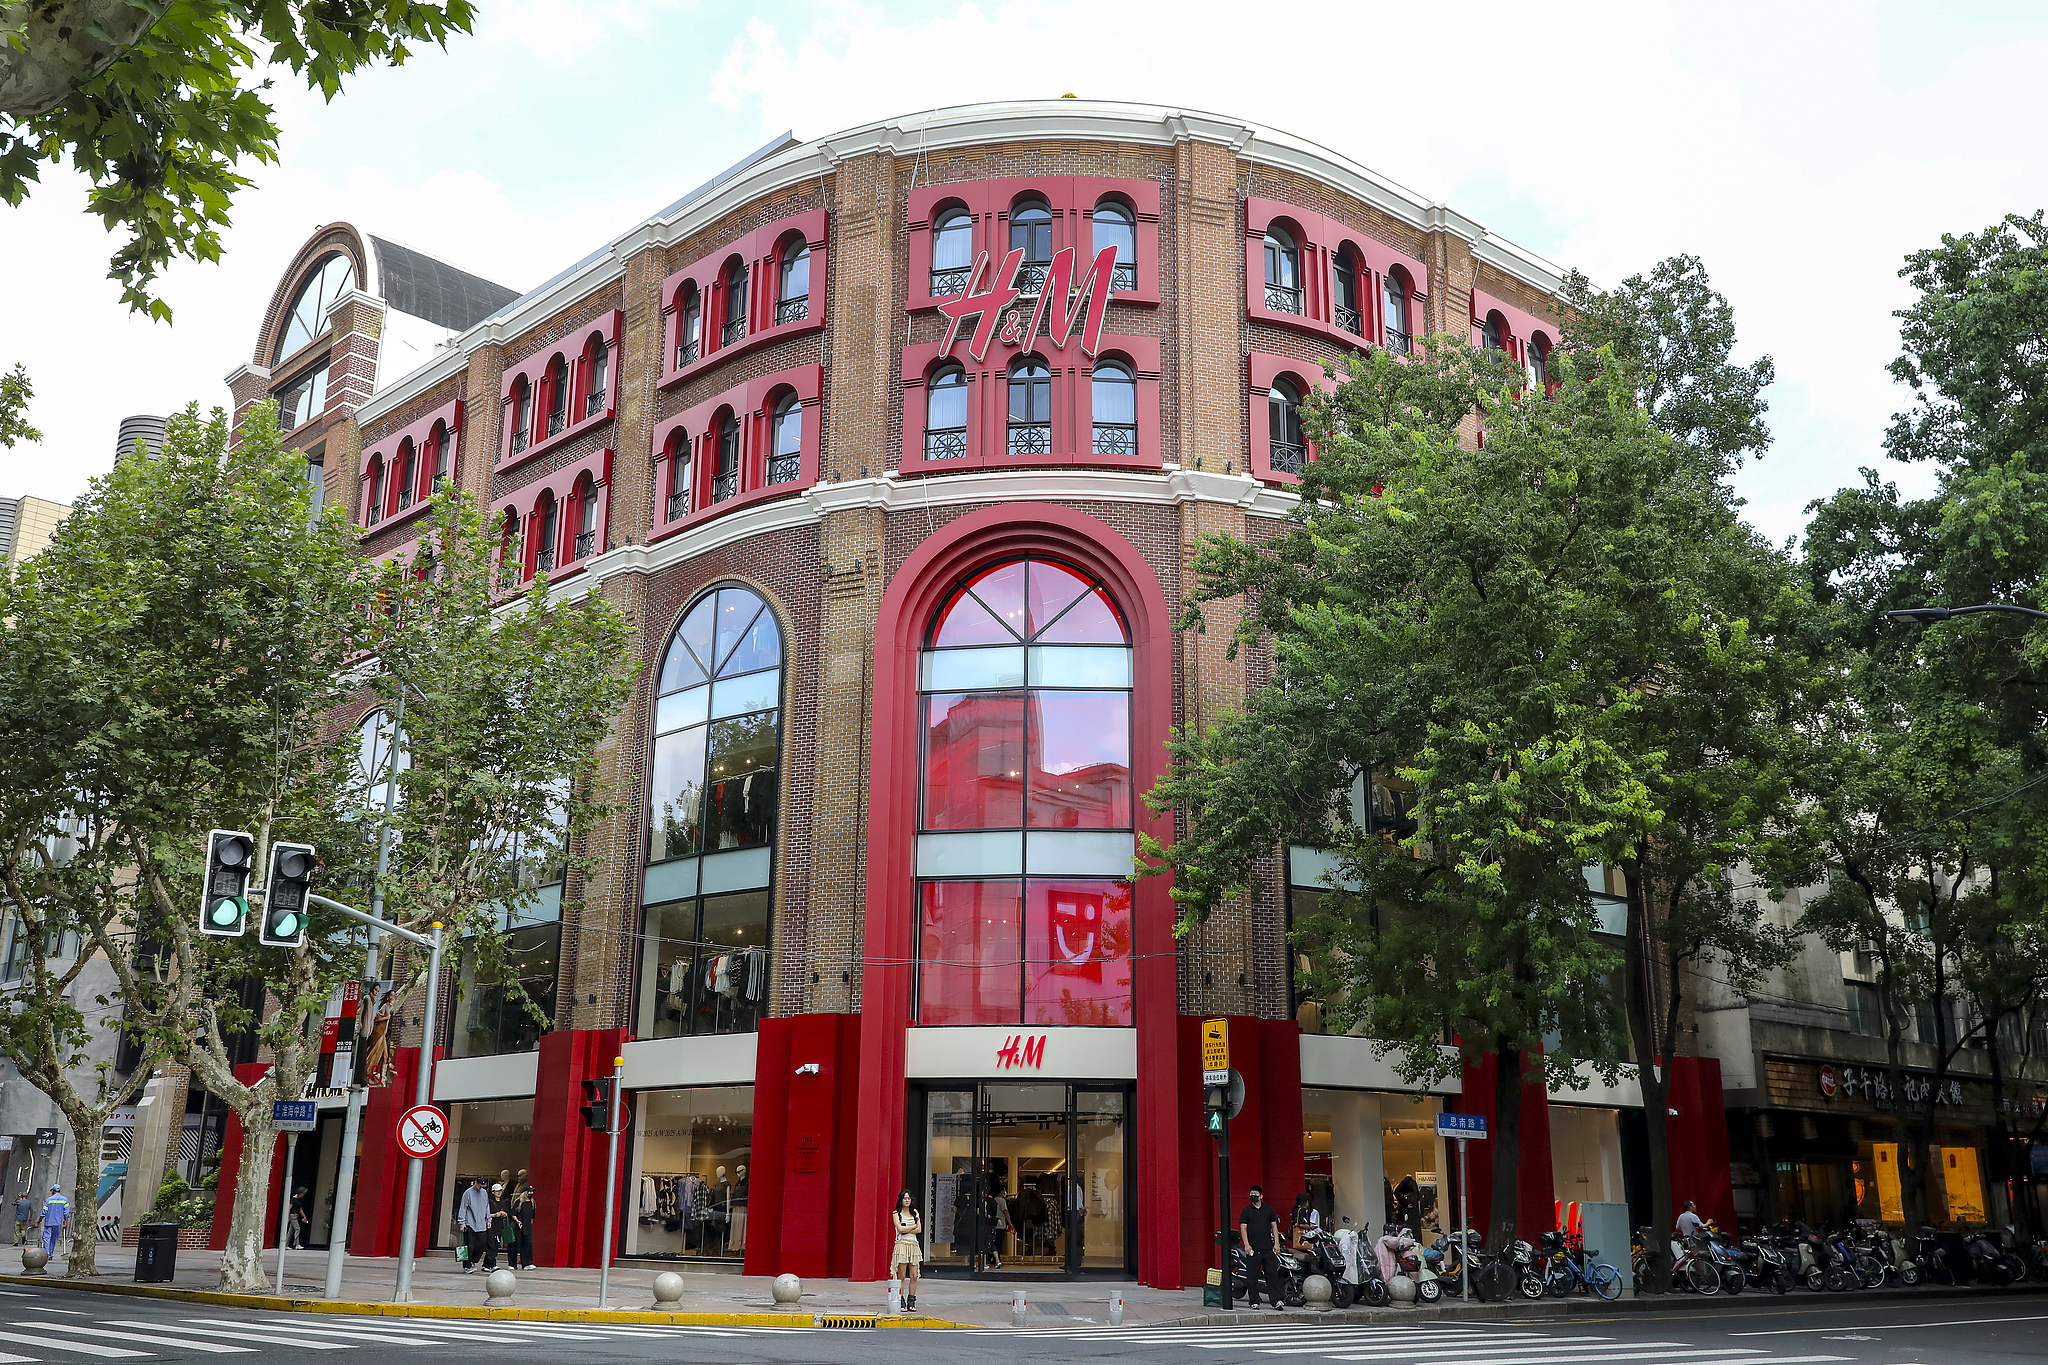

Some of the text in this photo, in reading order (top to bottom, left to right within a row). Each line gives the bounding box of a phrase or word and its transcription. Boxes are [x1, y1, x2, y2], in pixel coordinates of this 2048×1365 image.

[938, 244, 1119, 363] H&M
[996, 1034, 1047, 1069] H&M
[1450, 1116, 1476, 1128] 思南路
